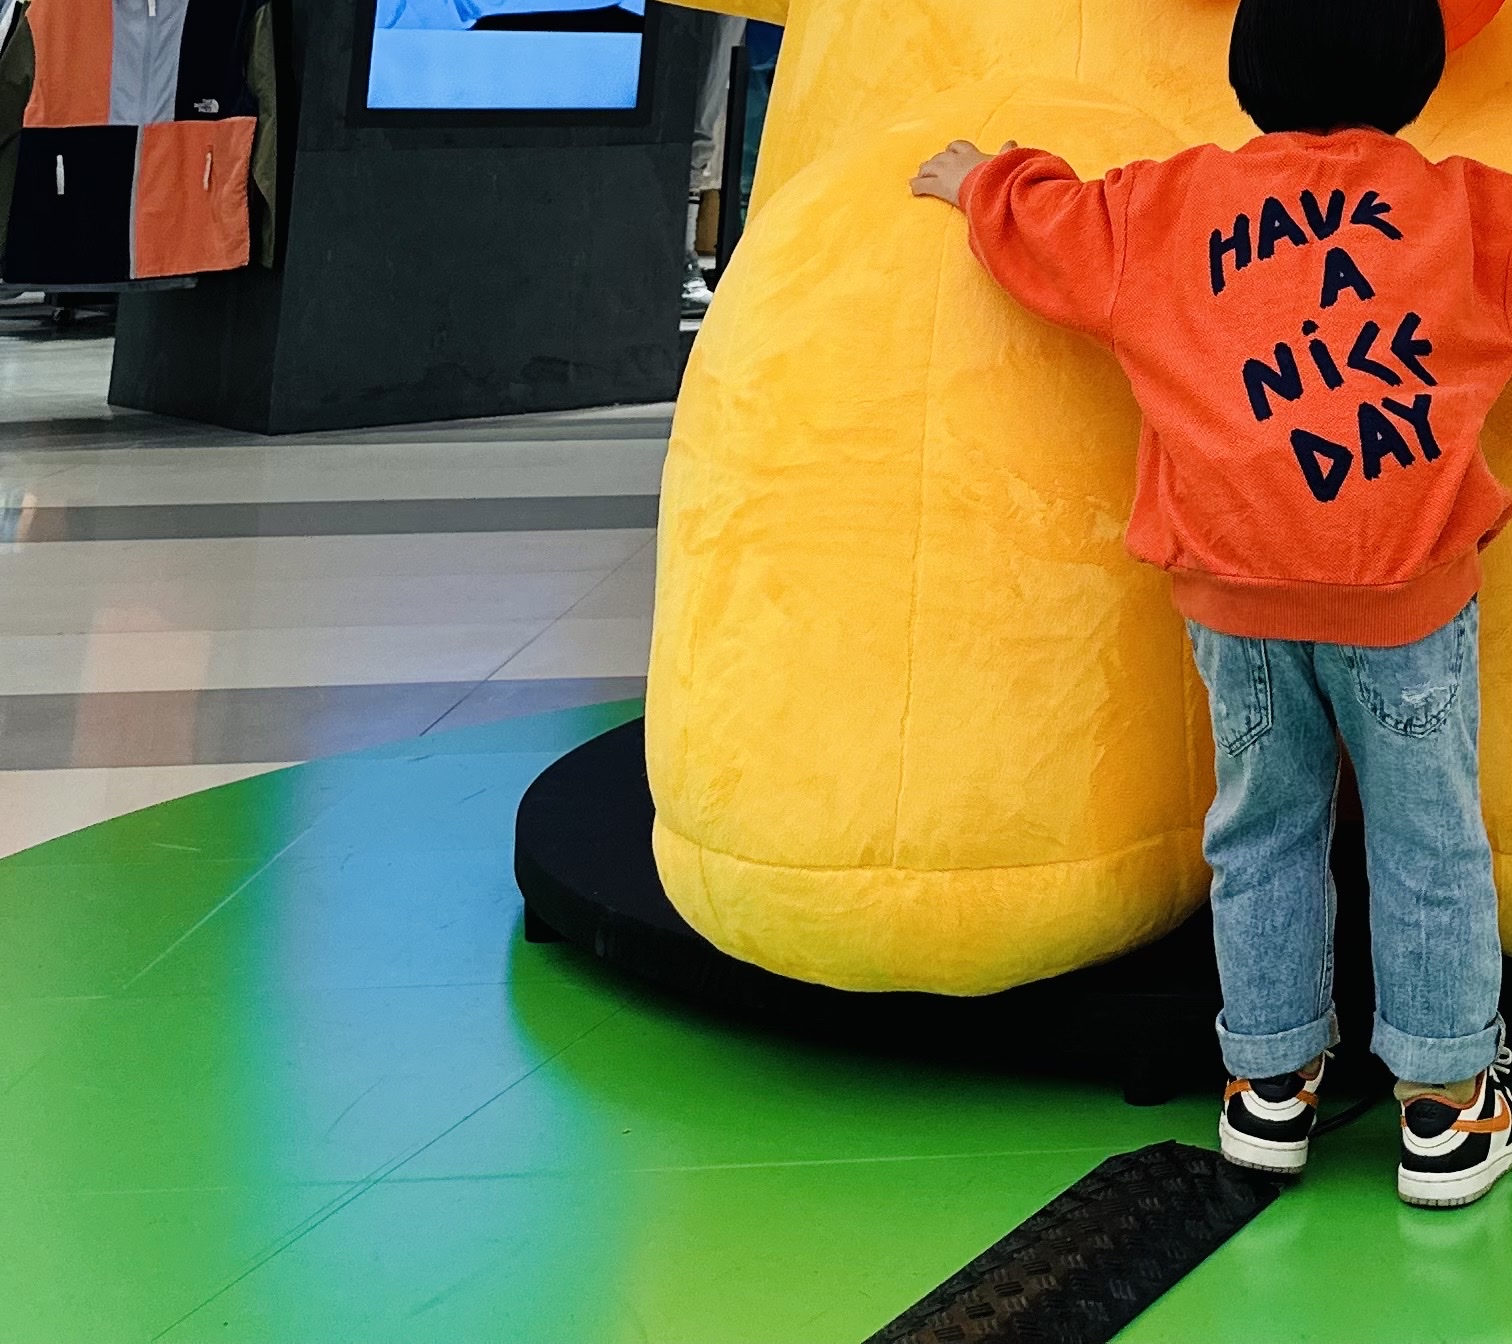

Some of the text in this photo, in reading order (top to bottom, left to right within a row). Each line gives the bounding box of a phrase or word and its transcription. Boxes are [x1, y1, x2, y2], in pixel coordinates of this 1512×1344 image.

[1209, 189, 1404, 296] HAVE
[1320, 247, 1376, 309] A
[1290, 394, 1442, 502] DAY
